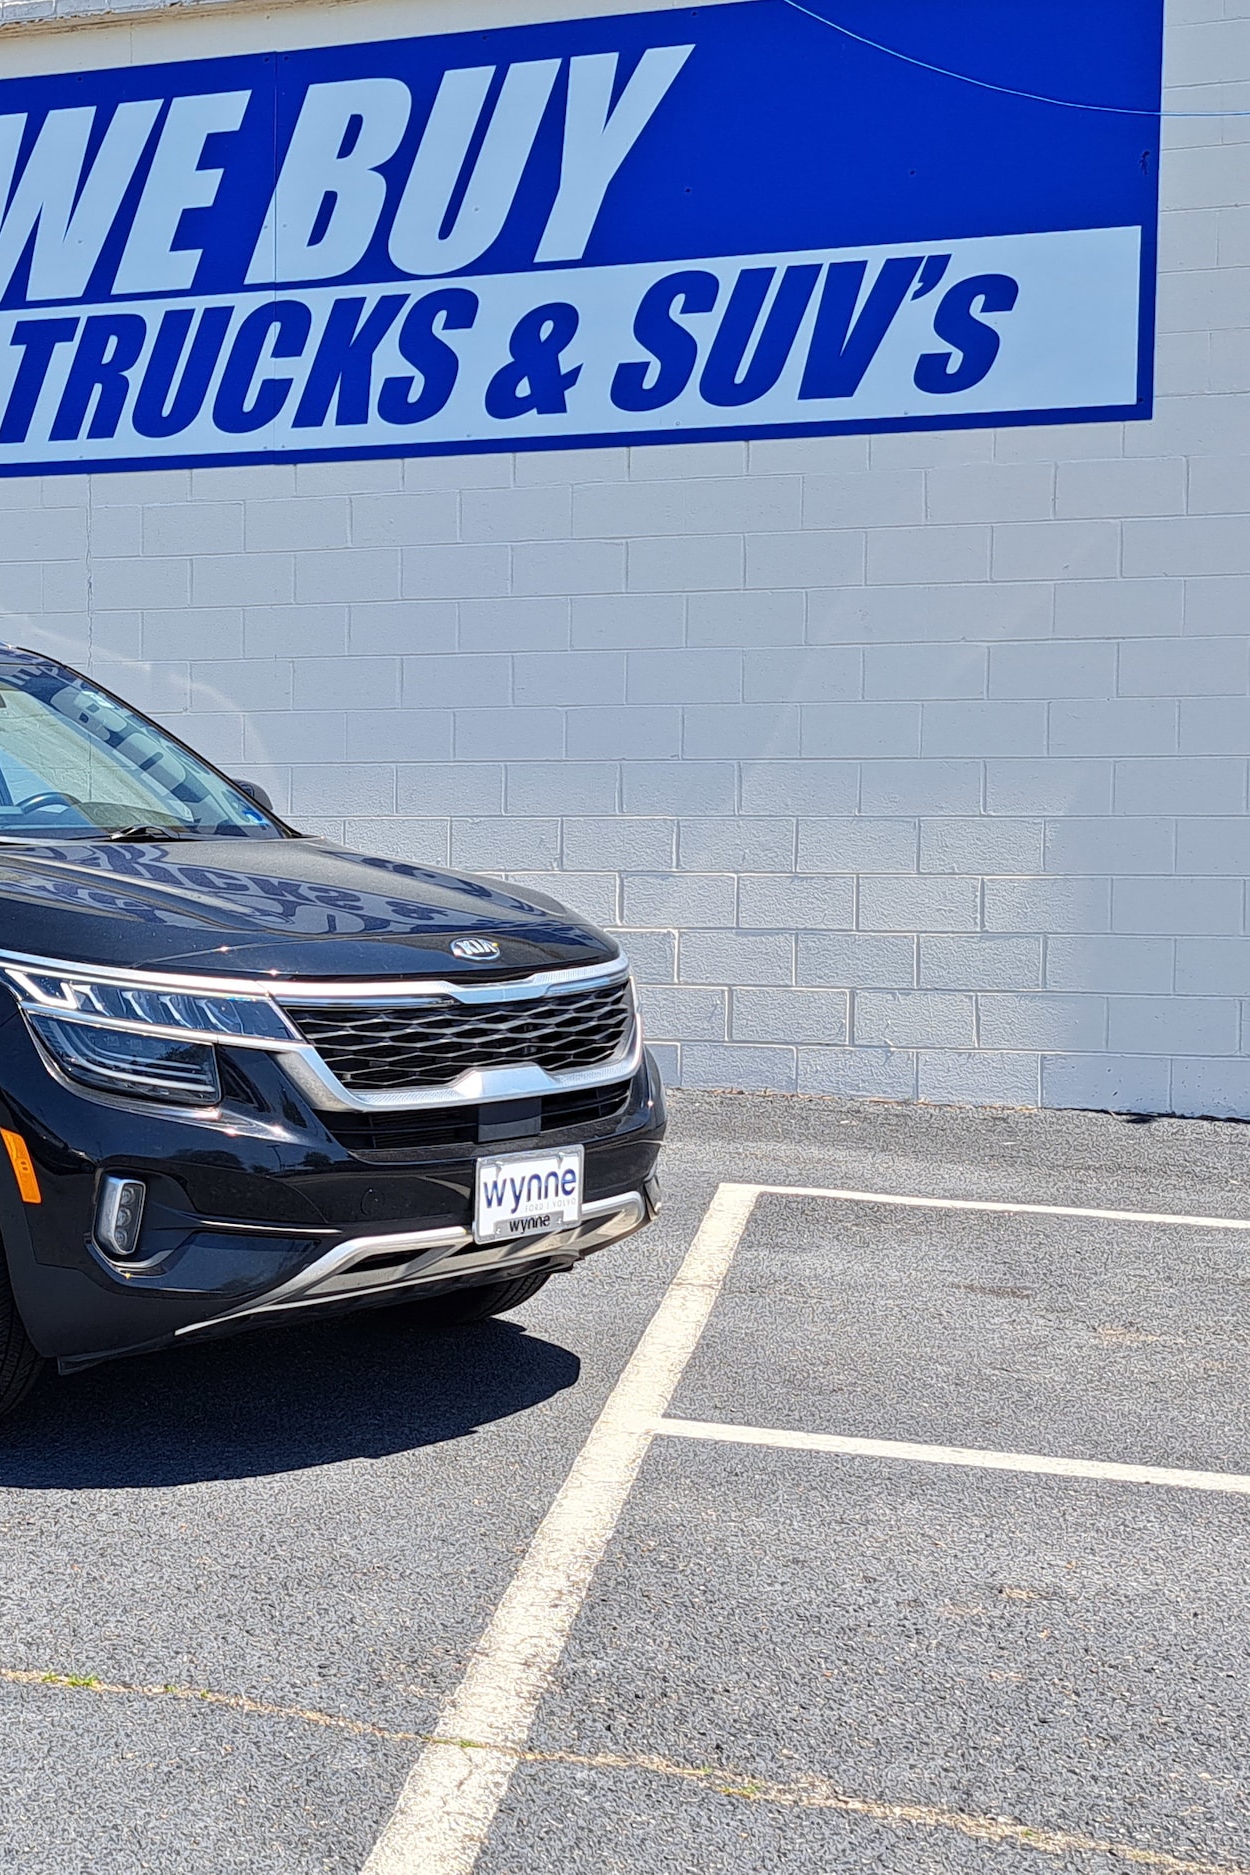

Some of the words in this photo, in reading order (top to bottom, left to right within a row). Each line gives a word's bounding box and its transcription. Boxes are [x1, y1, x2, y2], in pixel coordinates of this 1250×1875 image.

[244, 44, 696, 285] BUY
[485, 302, 583, 421] &
[455, 939, 497, 955] KIA
[483, 1168, 576, 1214] wynne
[509, 1214, 551, 1235] wynne
